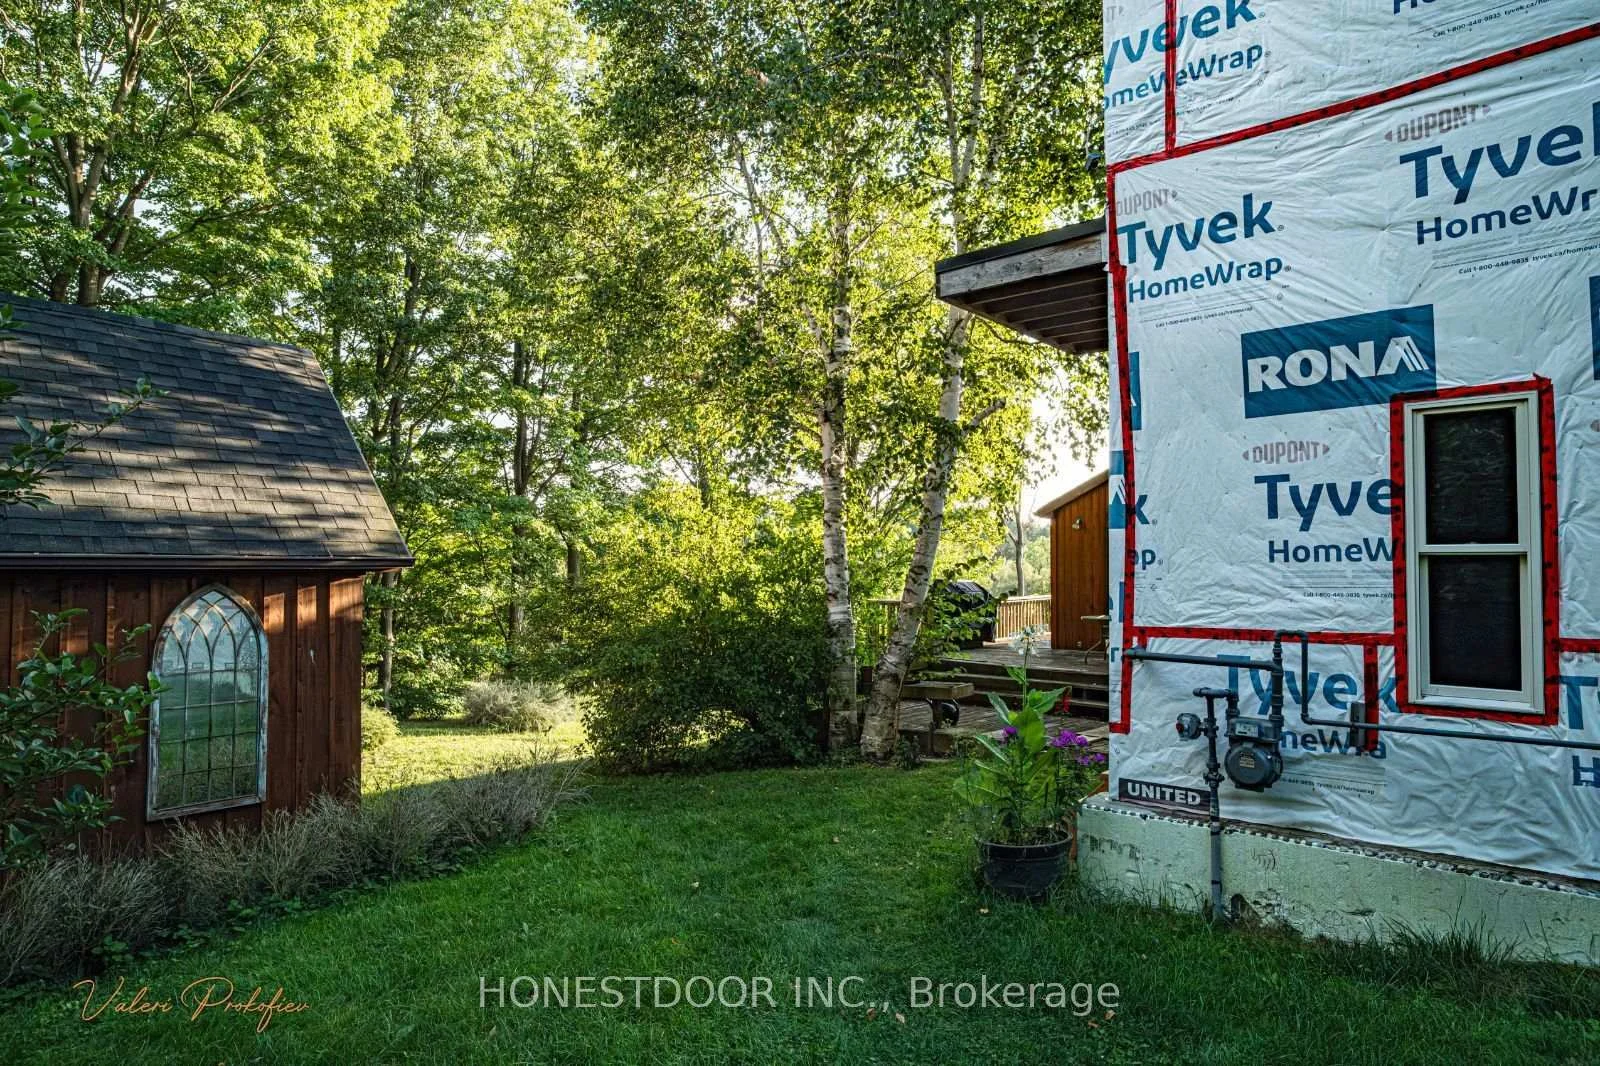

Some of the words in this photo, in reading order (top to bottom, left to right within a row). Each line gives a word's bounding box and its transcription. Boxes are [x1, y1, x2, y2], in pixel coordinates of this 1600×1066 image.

[1397, 104, 1480, 142] DUPONT
[1116, 192, 1276, 271] Tyvek
[1128, 257, 1283, 303] HomeWrap
[1247, 335, 1430, 393] RONA
[1252, 440, 1321, 465] DUPONT
[1127, 781, 1202, 806] UNITED
